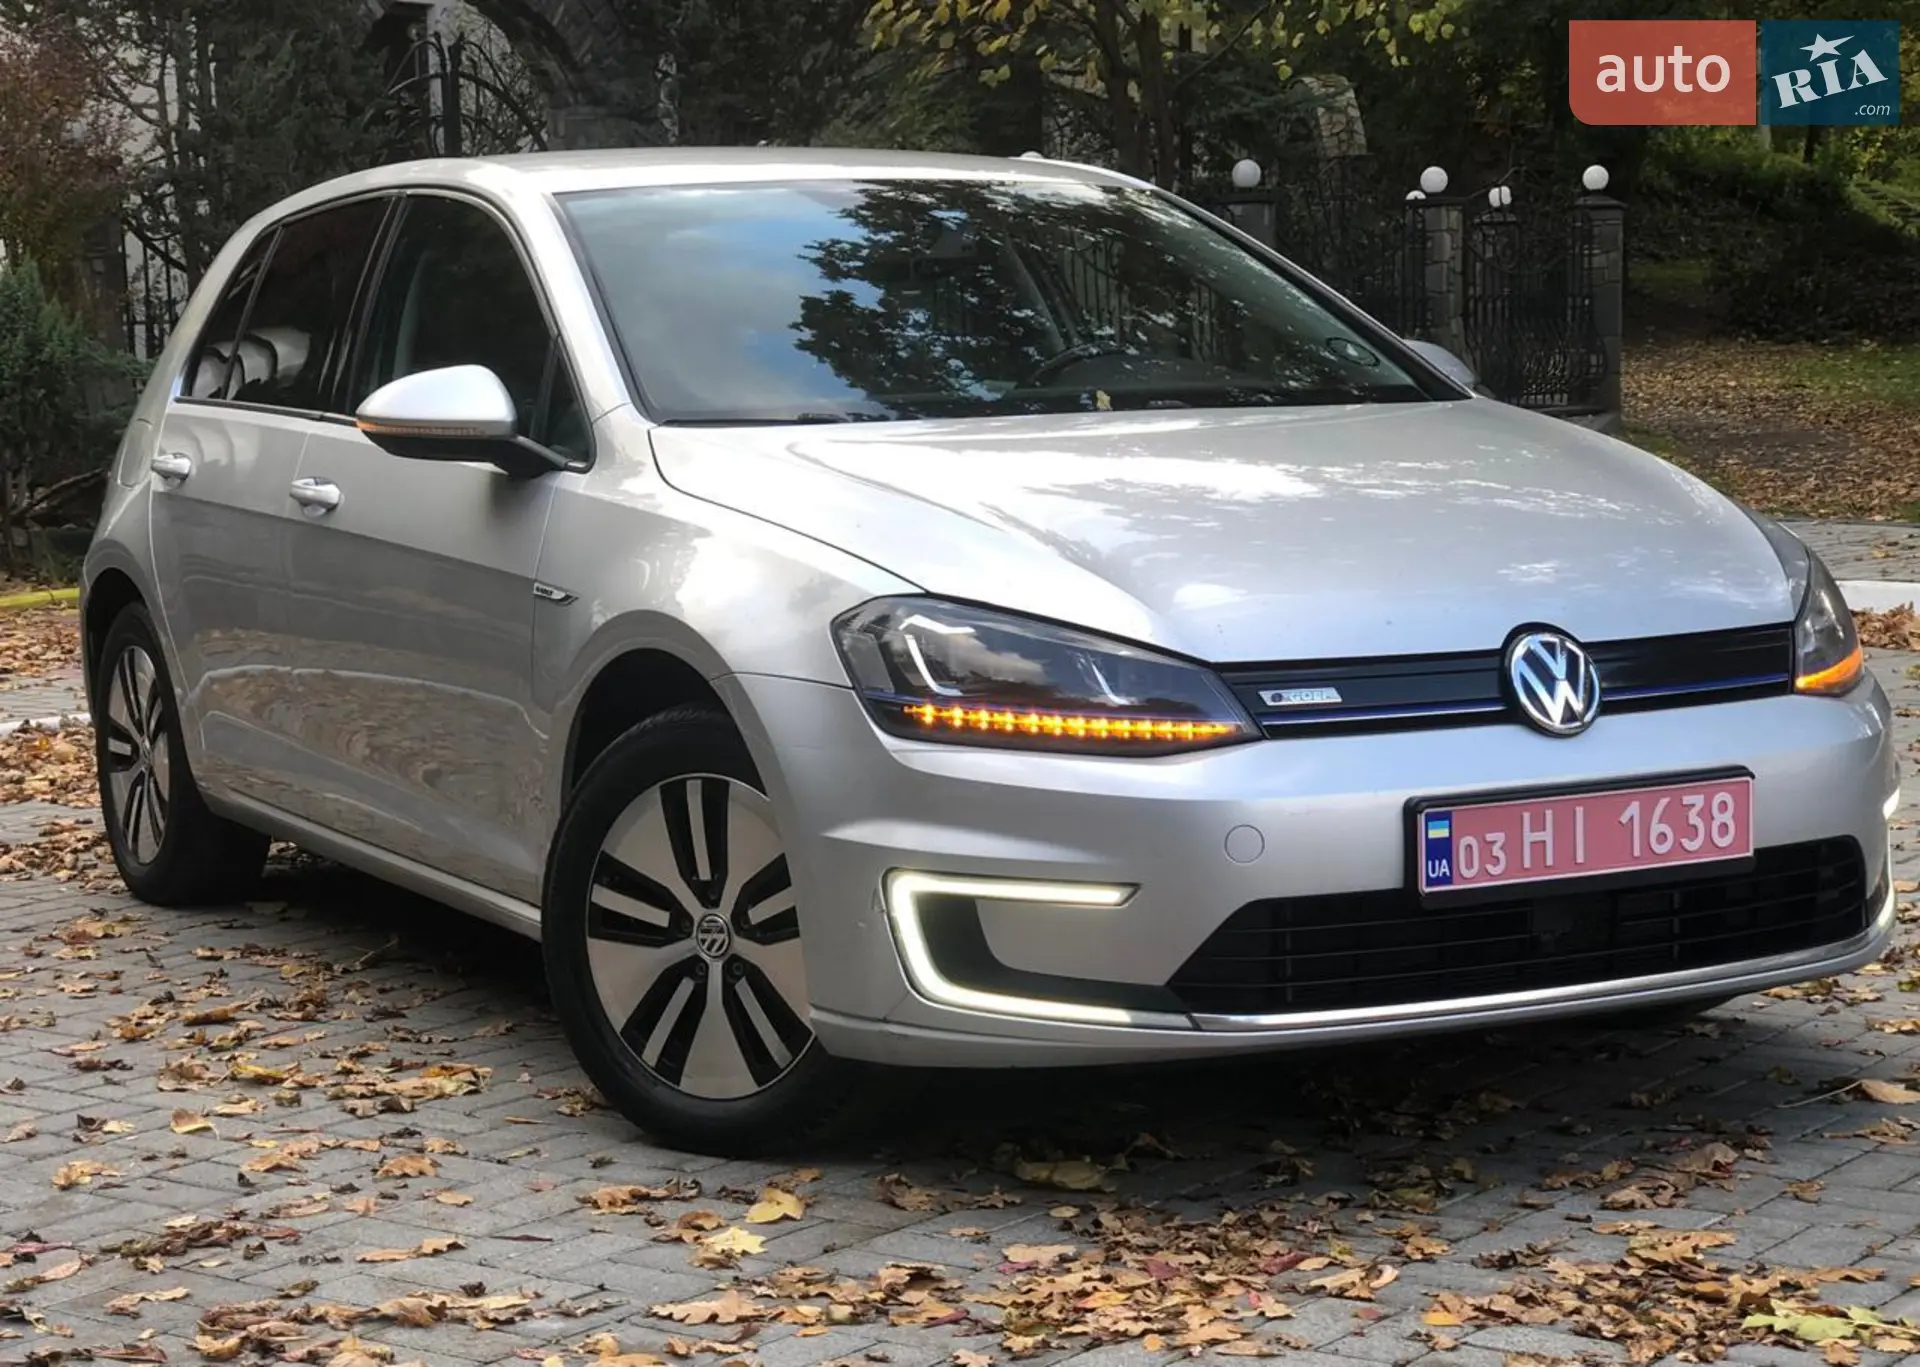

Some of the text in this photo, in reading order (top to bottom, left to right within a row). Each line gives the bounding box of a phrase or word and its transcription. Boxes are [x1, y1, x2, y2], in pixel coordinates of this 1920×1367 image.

[1458, 791, 1736, 879] 03 HI 1638
[1427, 859, 1450, 878] UA
